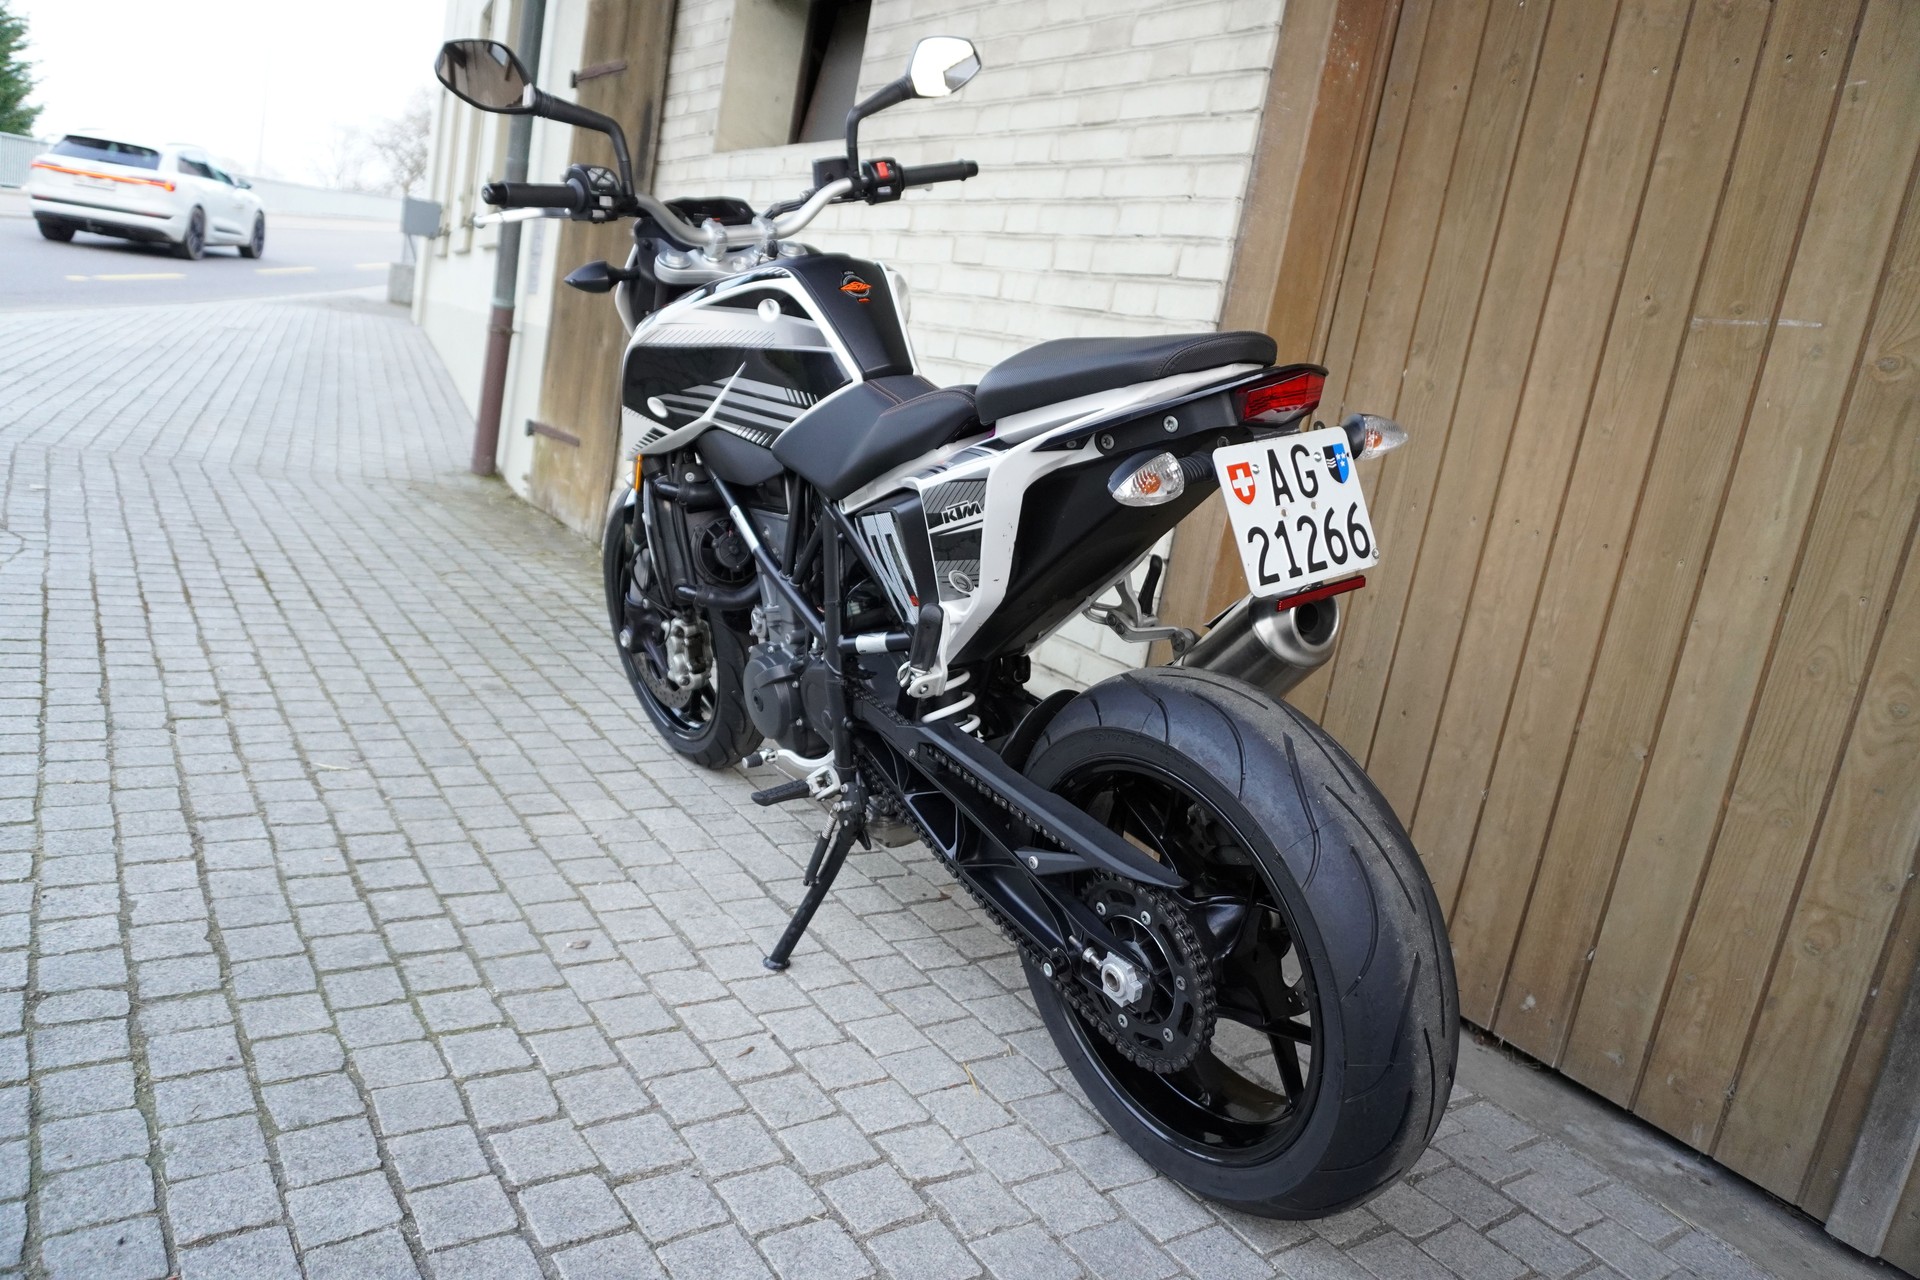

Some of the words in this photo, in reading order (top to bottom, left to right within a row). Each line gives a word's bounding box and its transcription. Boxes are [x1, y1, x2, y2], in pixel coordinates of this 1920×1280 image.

[1267, 444, 1319, 507] AG
[942, 501, 982, 524] KTM
[1247, 501, 1371, 587] 21266
